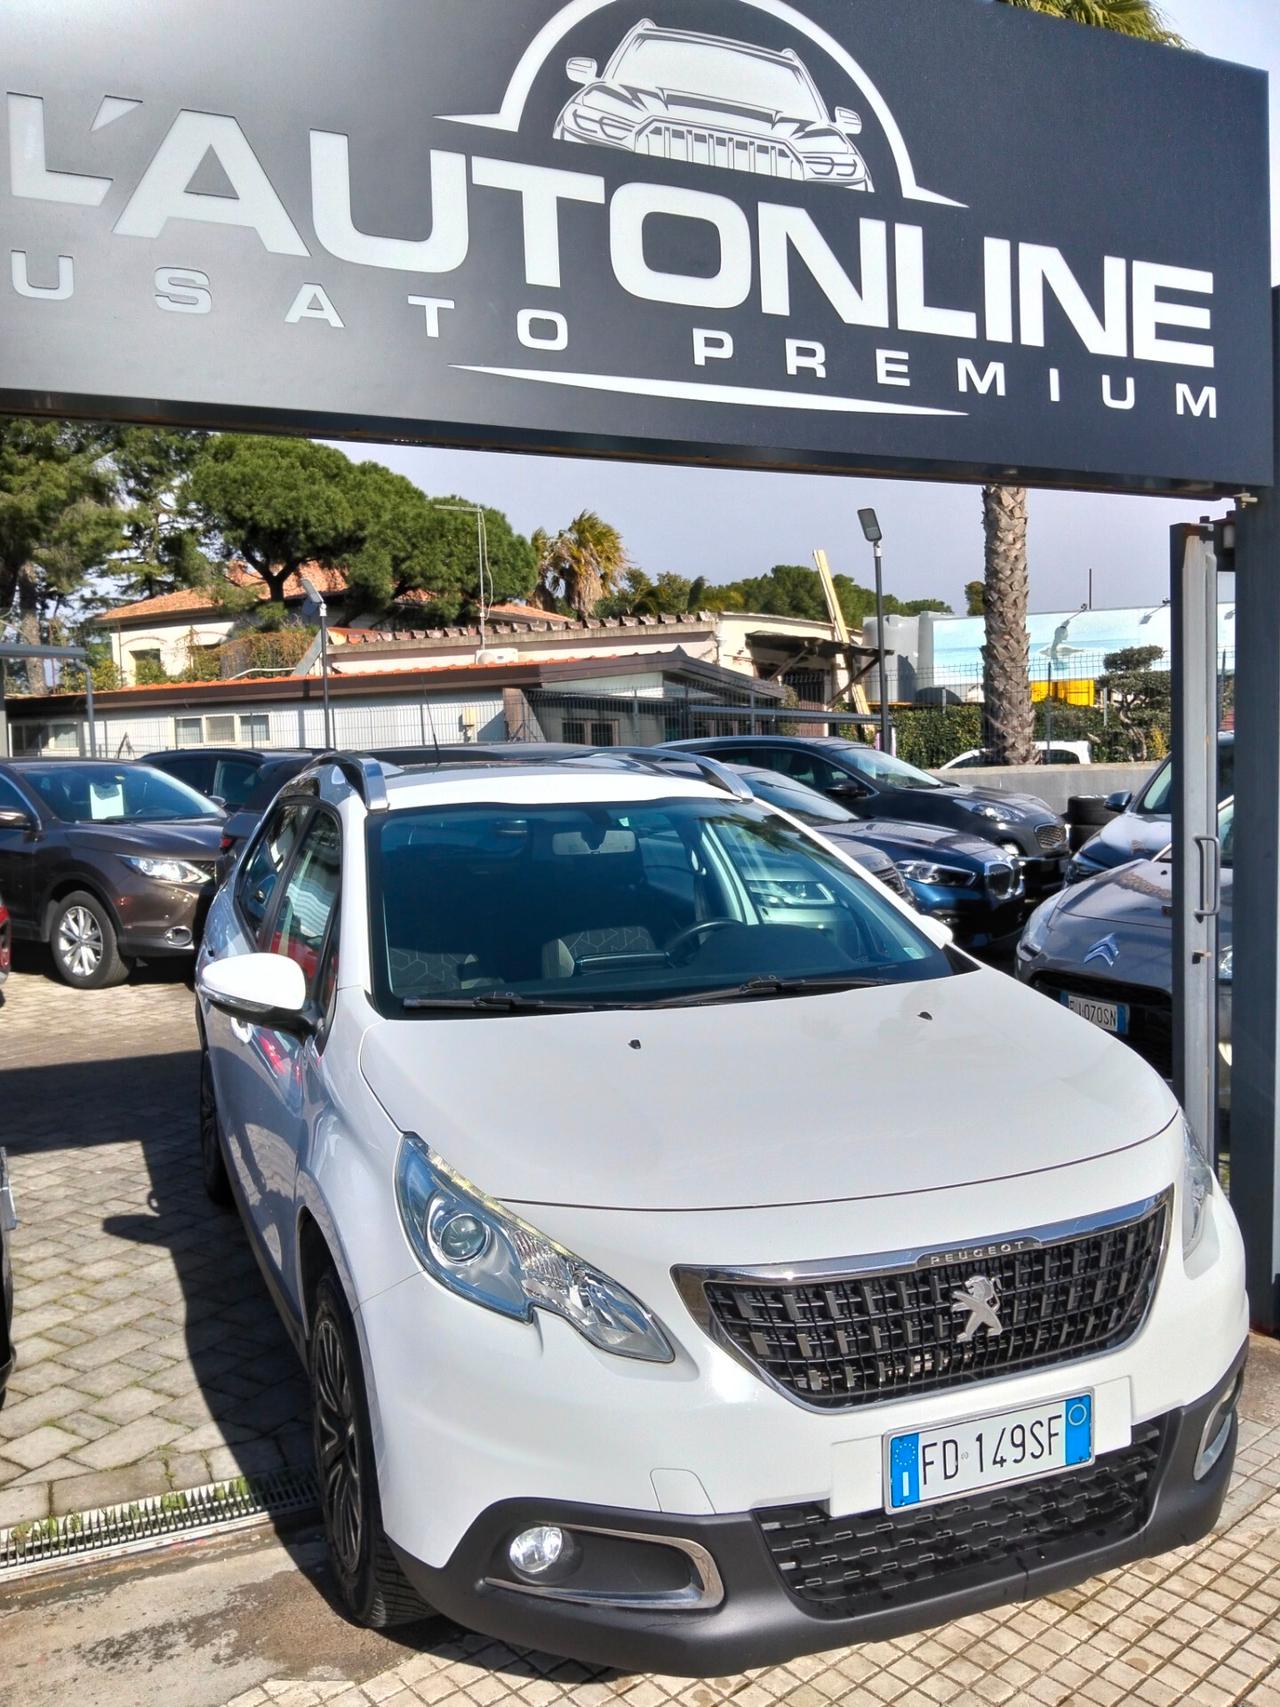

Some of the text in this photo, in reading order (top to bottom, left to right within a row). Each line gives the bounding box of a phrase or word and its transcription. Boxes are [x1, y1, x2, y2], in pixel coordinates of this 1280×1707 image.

[7, 91, 1215, 368] L'AUTONLINE
[10, 249, 1218, 419] USATO PREMIUM
[931, 1241, 1024, 1265] PEUGEOT
